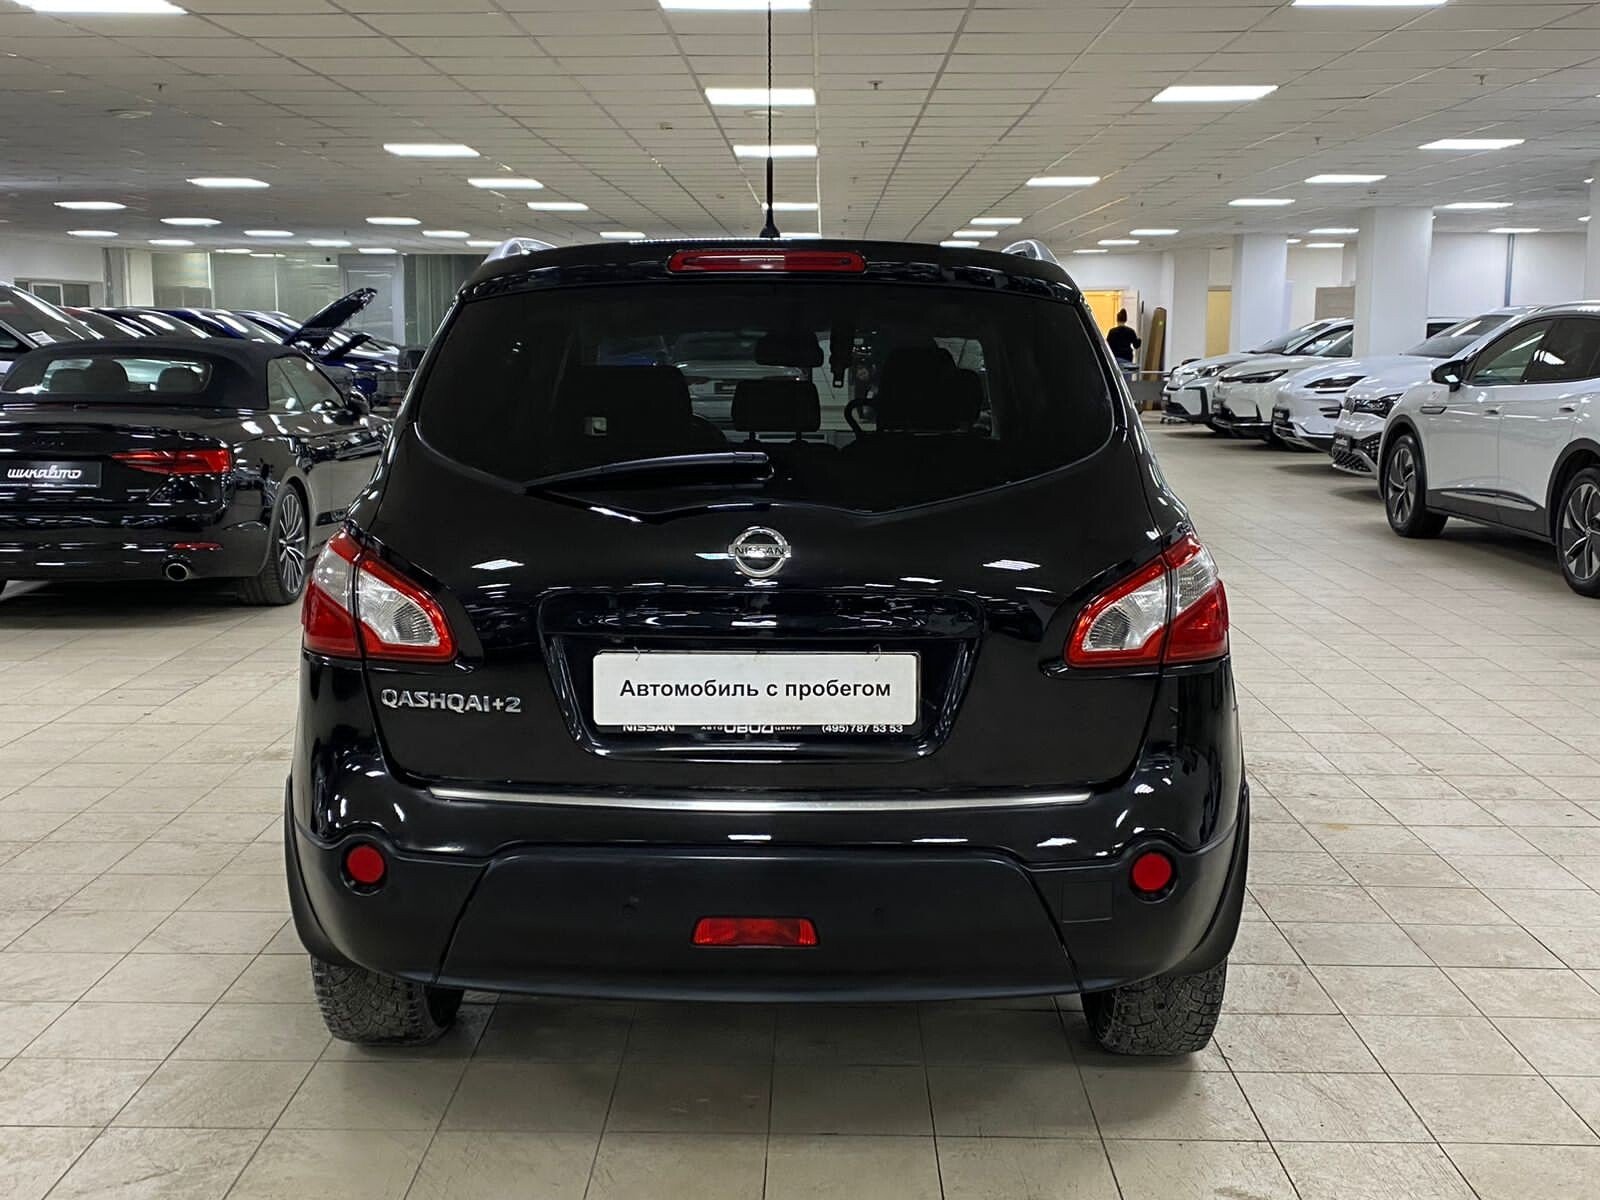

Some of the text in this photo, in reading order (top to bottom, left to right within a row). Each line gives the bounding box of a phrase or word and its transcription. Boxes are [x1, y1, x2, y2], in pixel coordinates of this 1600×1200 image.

[619, 679, 890, 701] Автомобиль с пробегом
